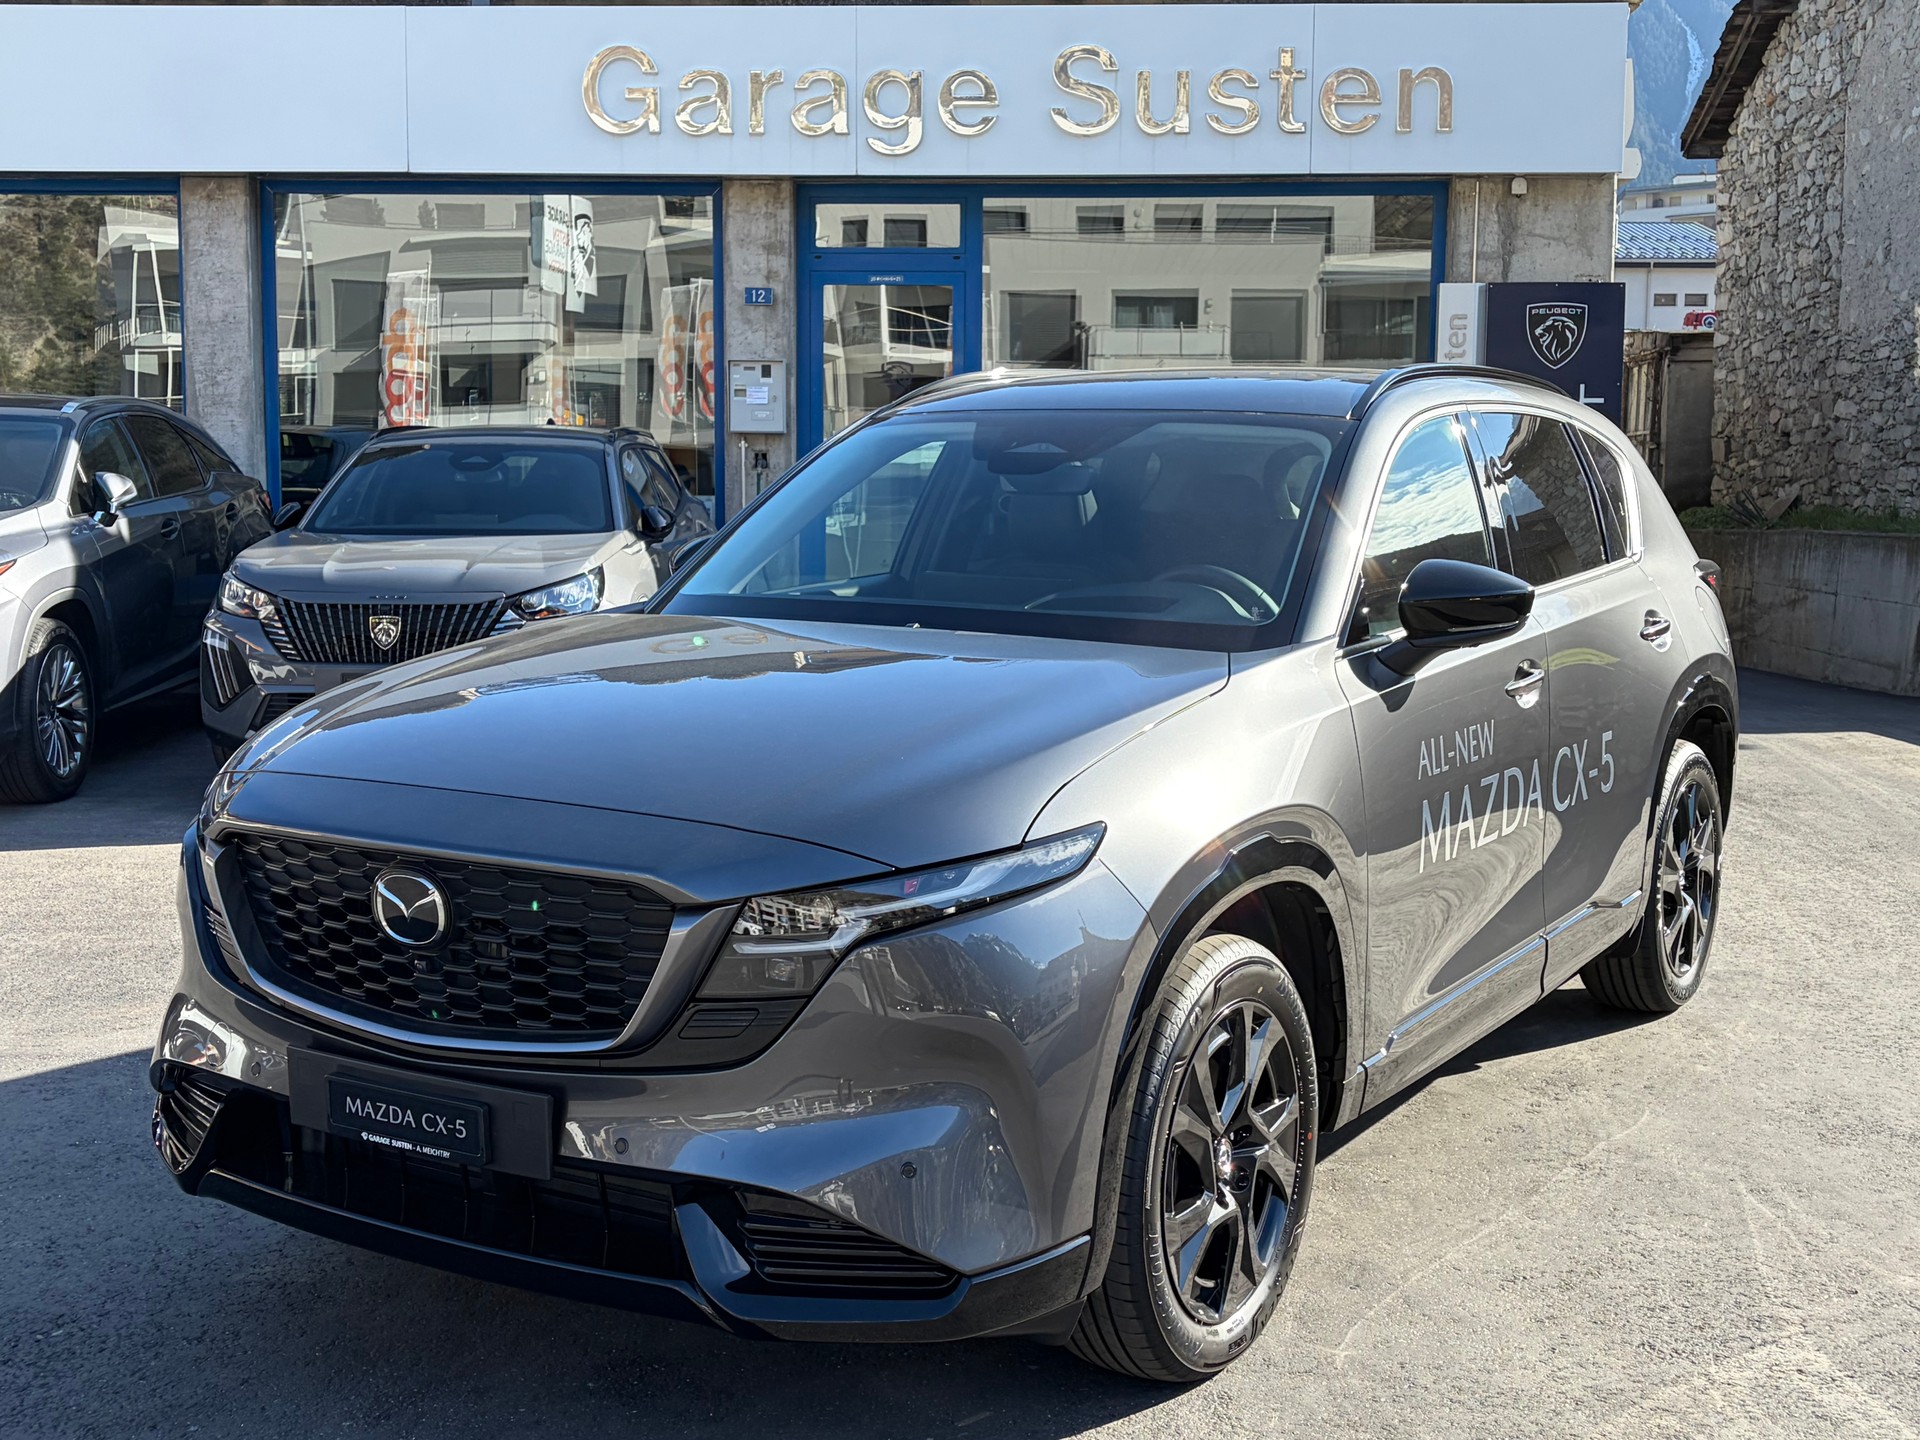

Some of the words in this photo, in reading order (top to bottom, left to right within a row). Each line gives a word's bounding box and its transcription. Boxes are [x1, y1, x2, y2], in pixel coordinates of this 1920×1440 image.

[581, 44, 1000, 156] Garage
[1050, 43, 1454, 135] Susten
[752, 289, 766, 303] 12
[1444, 314, 1468, 362] ten
[1418, 719, 1495, 780] ALL-NEW
[1419, 758, 1544, 873] MAZDA
[1552, 730, 1615, 812] CX-5
[345, 1096, 416, 1128] MAZDA
[421, 1113, 467, 1139] CX-5
[368, 1134, 391, 1145] GARAGE
[391, 1139, 412, 1150] SUSTEN
